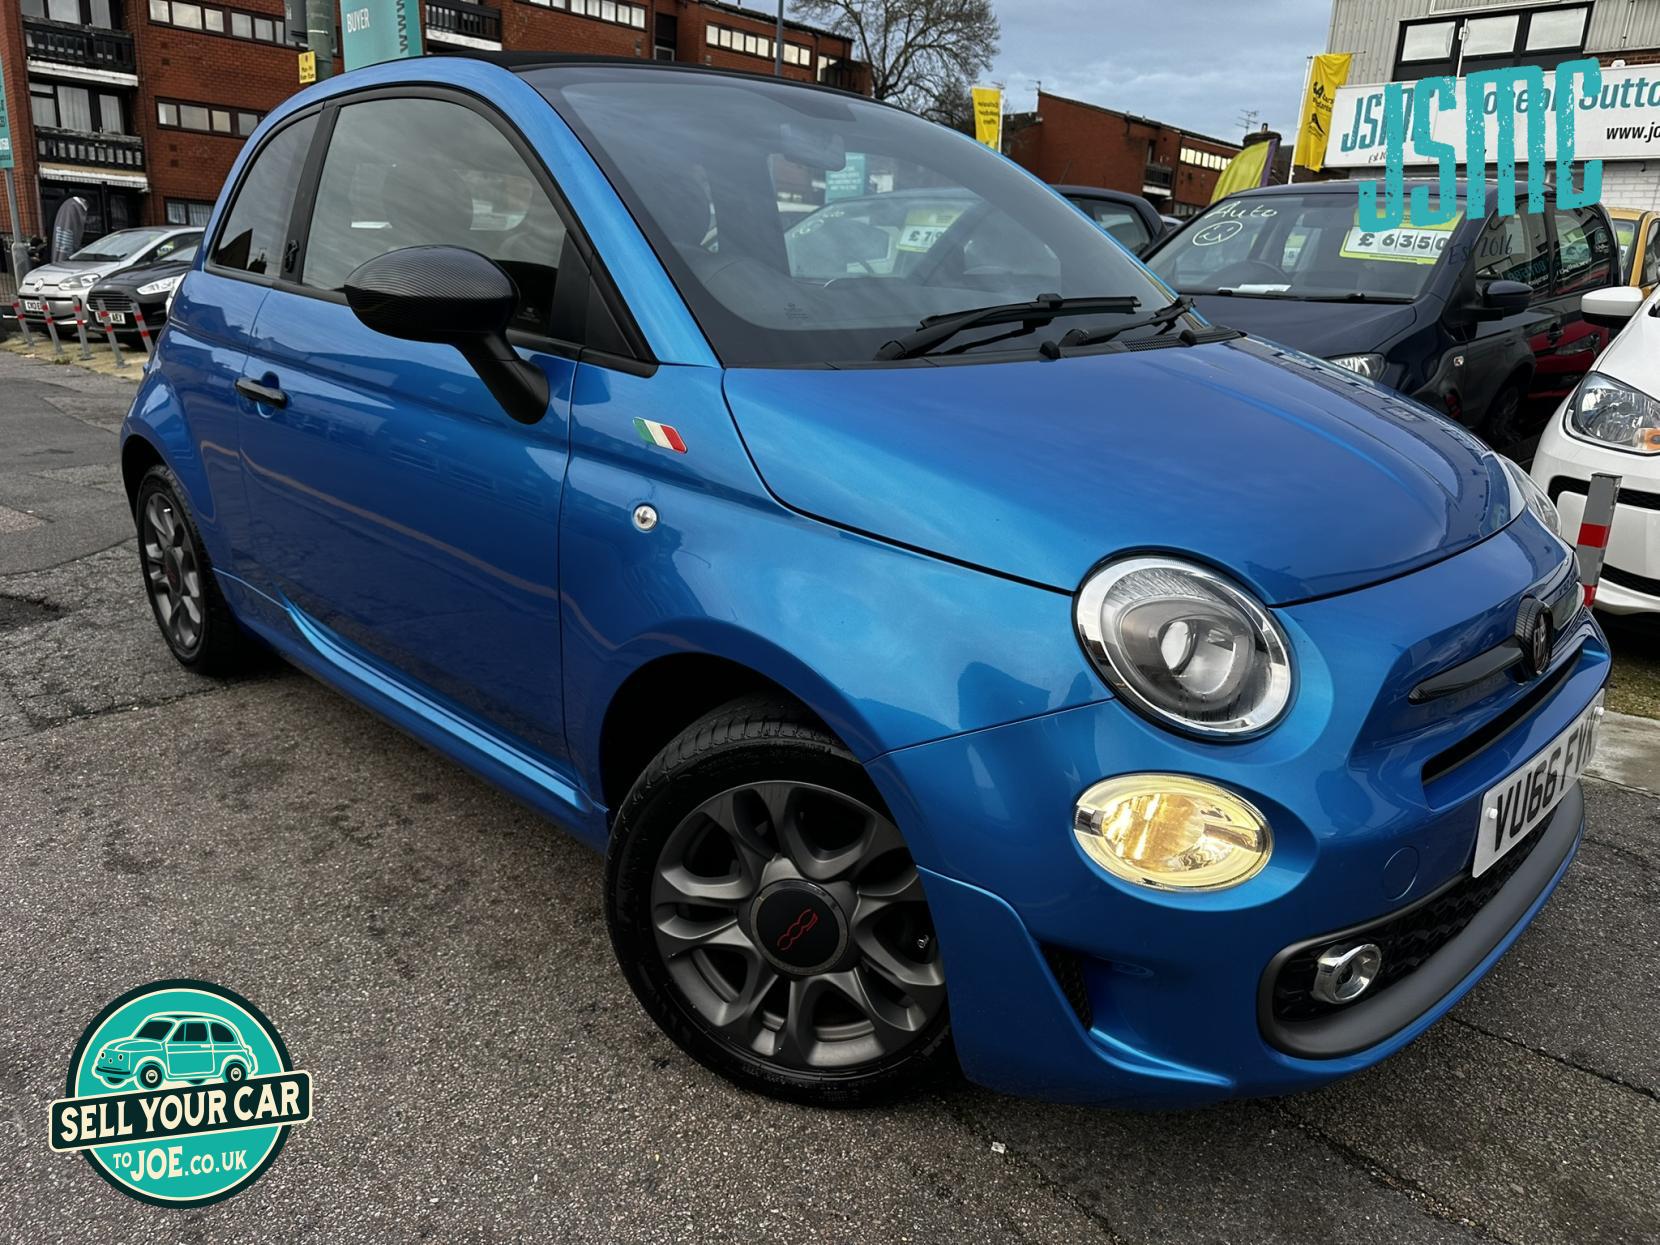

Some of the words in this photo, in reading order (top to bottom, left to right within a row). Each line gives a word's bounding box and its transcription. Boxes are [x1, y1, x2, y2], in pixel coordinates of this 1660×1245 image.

[346, 7, 370, 33] BUYER
[1340, 87, 1436, 152] JSM
[1204, 201, 1278, 219] Auto
[1494, 746, 1562, 853] VU66
